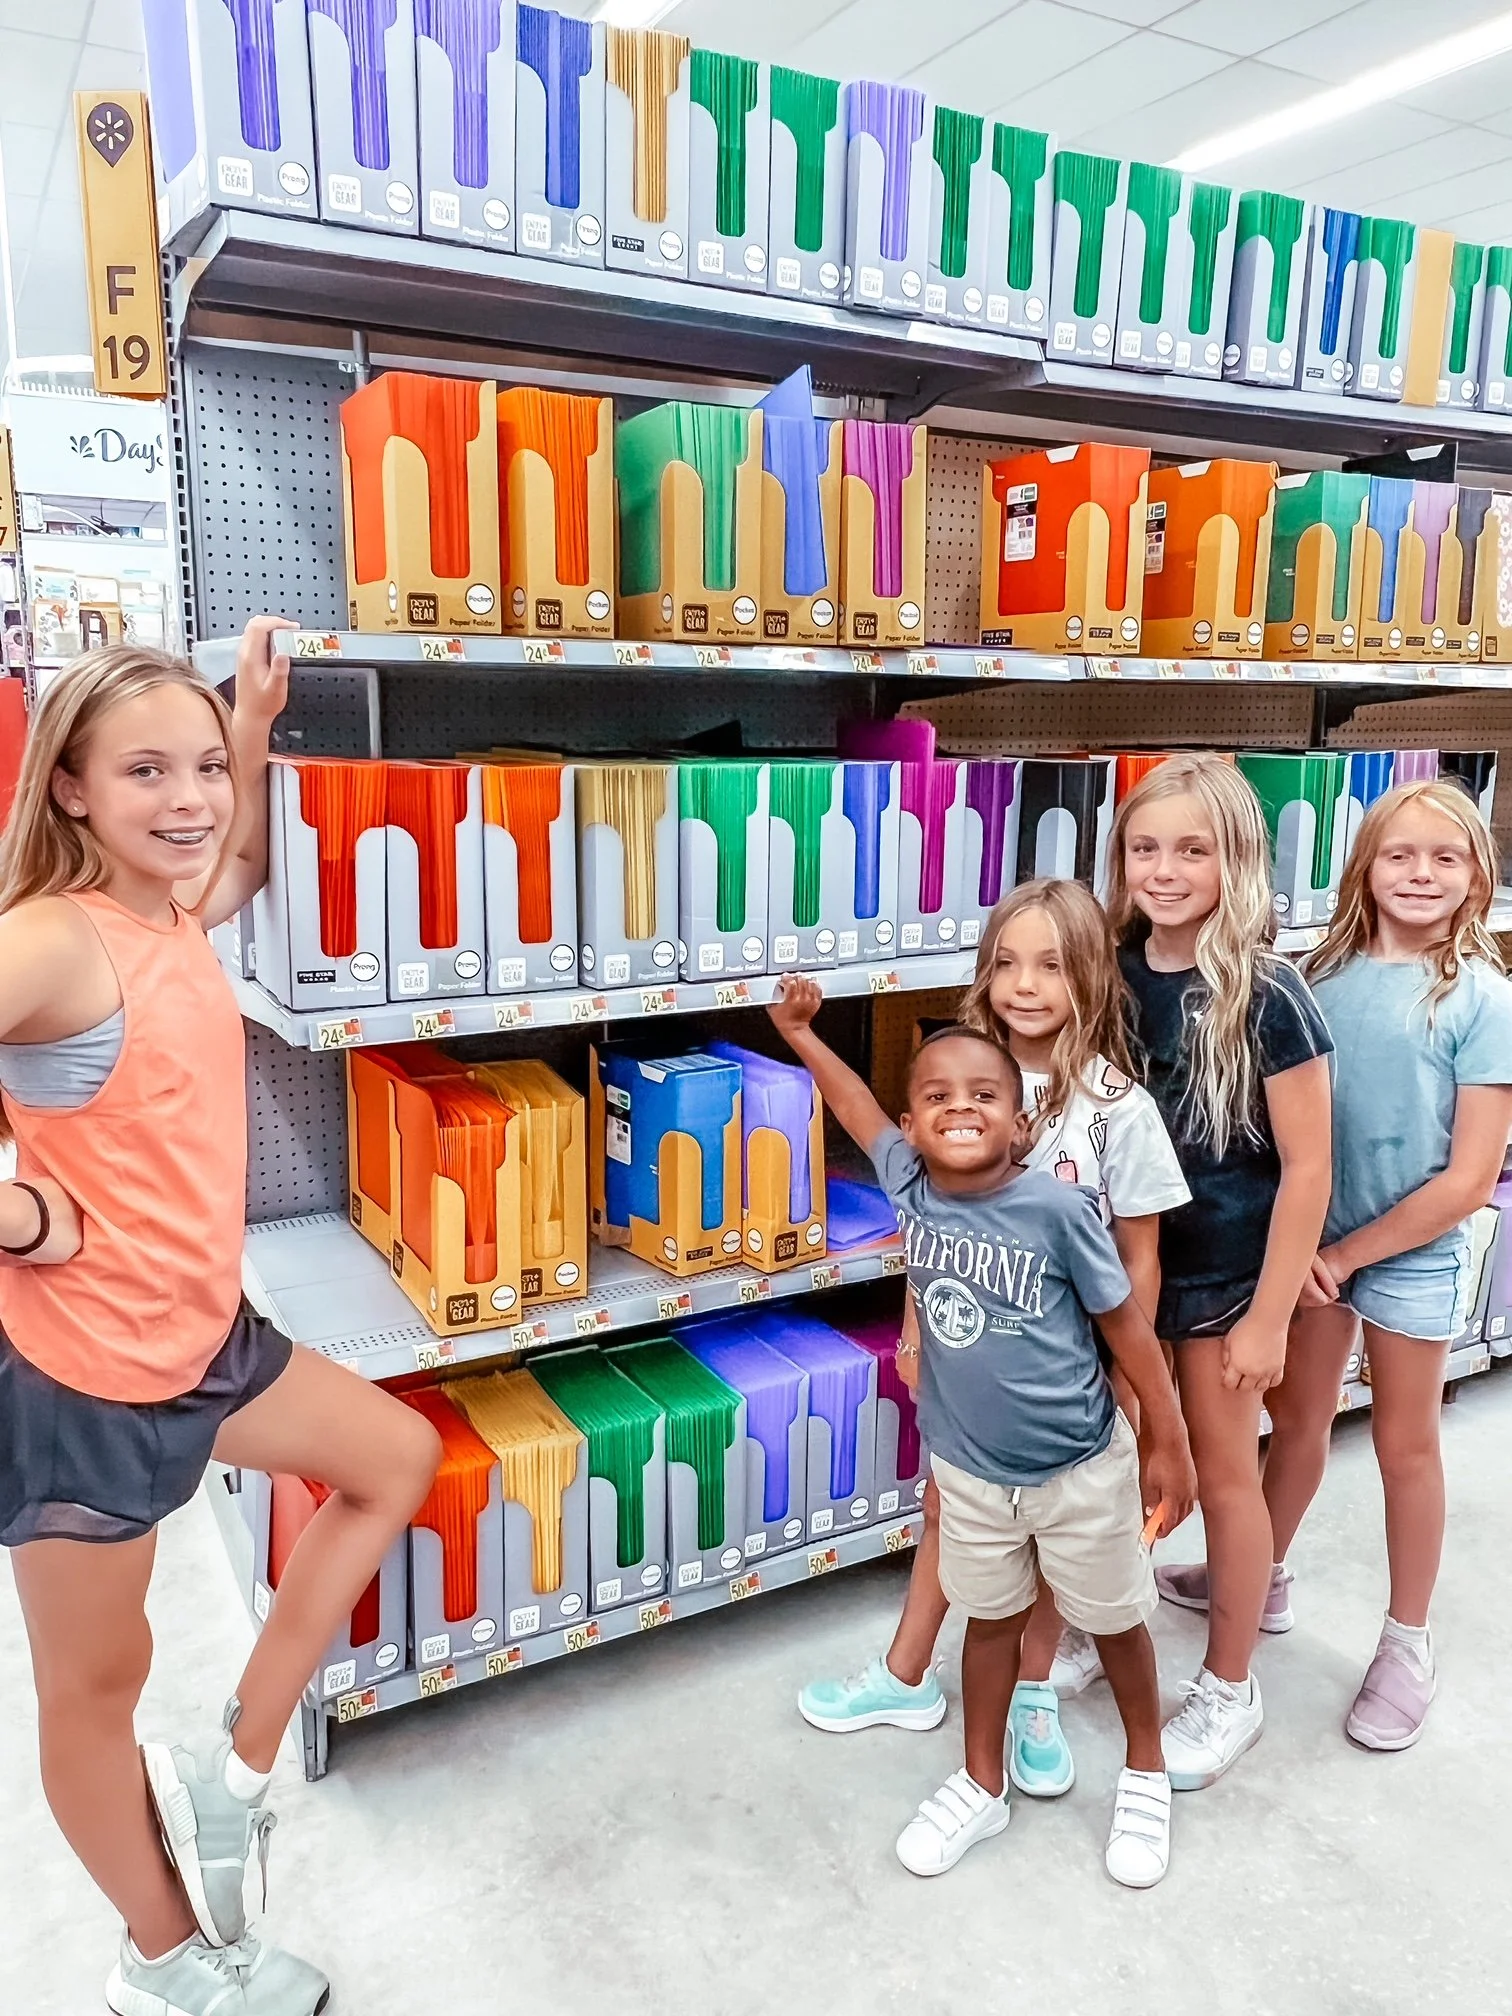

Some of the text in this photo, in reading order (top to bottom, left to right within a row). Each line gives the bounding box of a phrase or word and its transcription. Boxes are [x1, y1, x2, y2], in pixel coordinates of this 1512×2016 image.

[225, 173, 249, 190] GEAR
[282, 171, 306, 187] Prong
[106, 265, 136, 315] F
[103, 334, 150, 381] 19
[468, 594, 492, 603] Pocket
[412, 607, 435, 621] GEAR
[450, 617, 496, 628] Paper Folder
[540, 612, 560, 626] GEAR
[591, 625, 611, 633] Folder
[686, 617, 705, 630] GEAR
[297, 638, 321, 657] 24¢
[525, 645, 548, 663] 24¢
[353, 963, 376, 972] Prong
[404, 976, 425, 989] GEAR
[416, 1019, 437, 1038] 24¢
[321, 1028, 344, 1049] 24¢
[452, 1306, 474, 1321] GEAR
[660, 1302, 678, 1318] 50¢
[991, 1316, 1020, 1329] SURF
[513, 1331, 533, 1349] 50¢
[418, 1351, 438, 1370] 50¢
[567, 1632, 586, 1651] 50¢
[488, 1657, 507, 1676] 50¢
[421, 1676, 441, 1696] 50¢
[340, 1700, 361, 1721] 50¢
